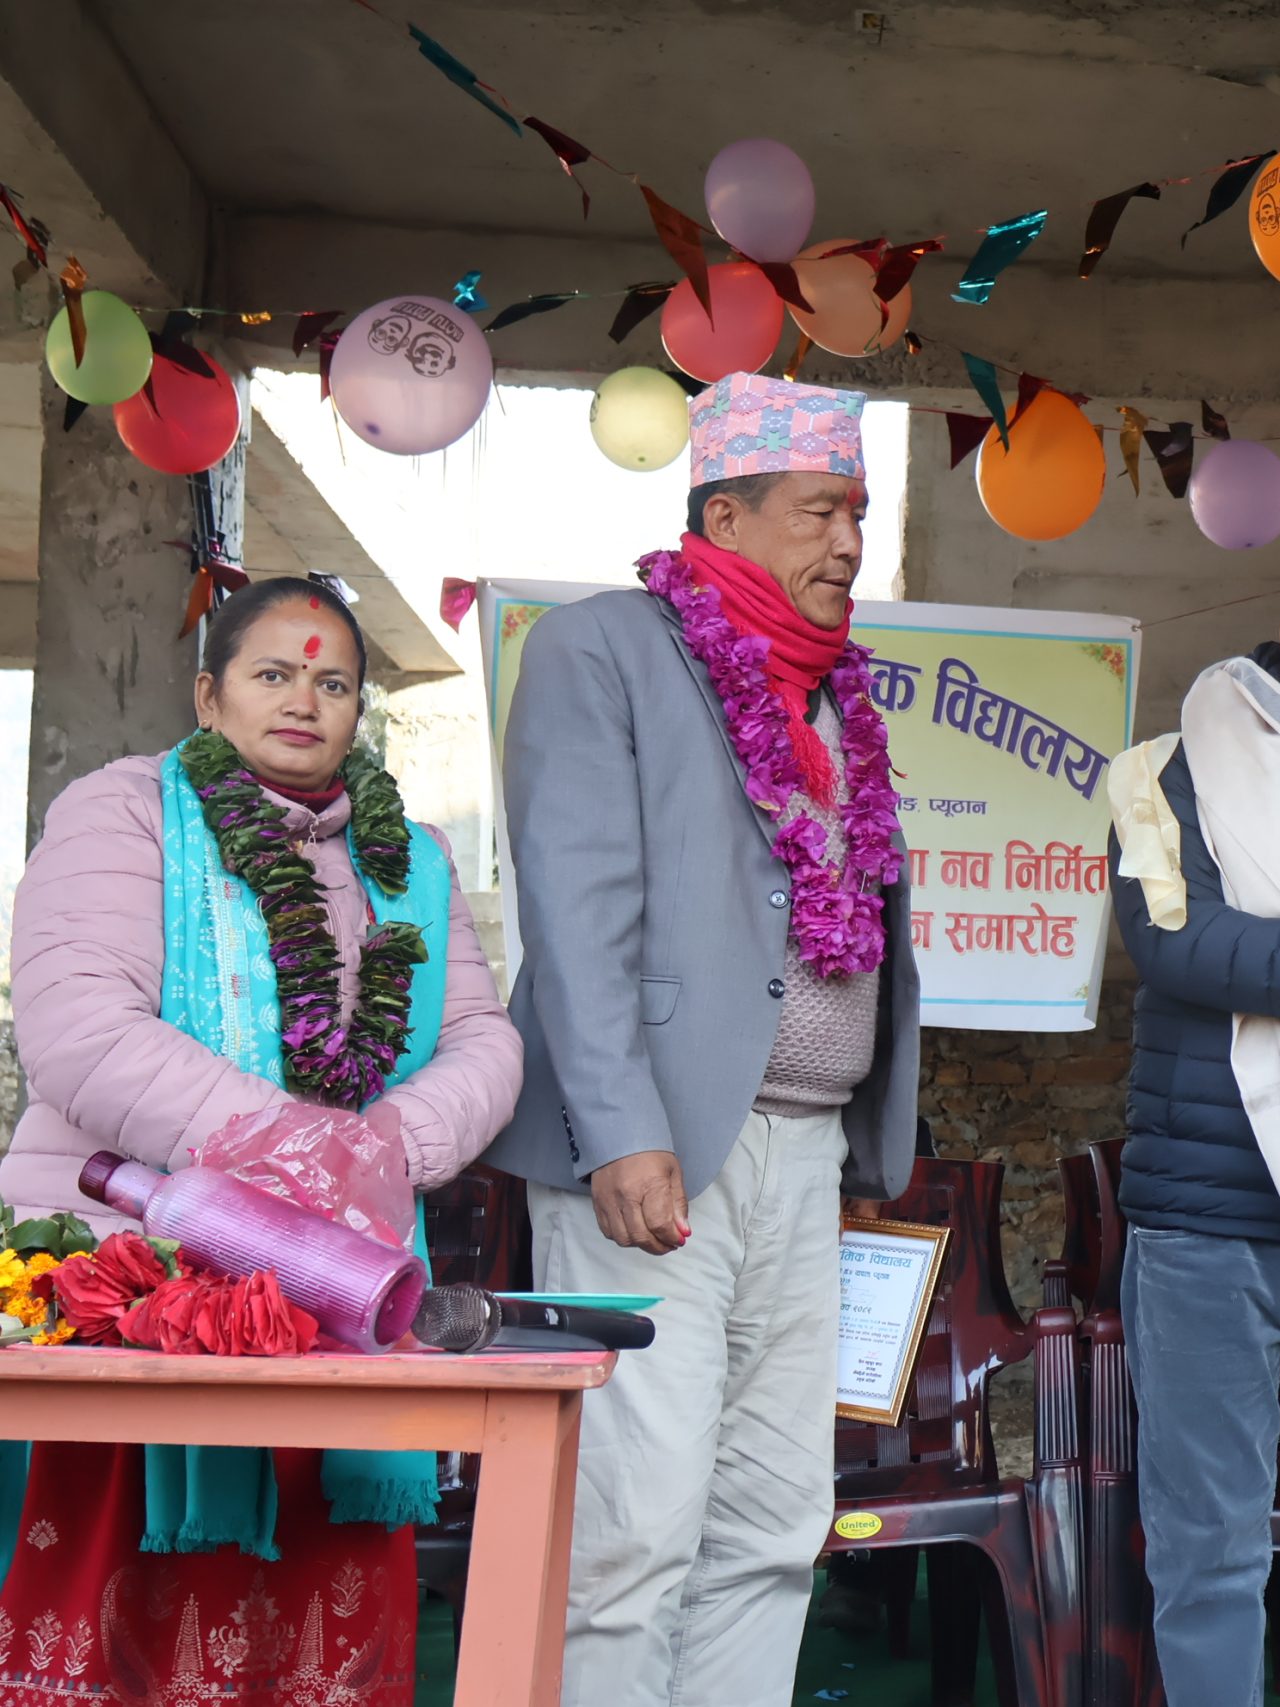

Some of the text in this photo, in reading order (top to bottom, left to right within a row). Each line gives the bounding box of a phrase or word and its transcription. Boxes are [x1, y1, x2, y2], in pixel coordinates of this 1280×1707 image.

[868, 657, 1110, 801] क विद्यालय
[928, 798, 987, 818] प्यूठान
[940, 850, 994, 890] नव
[1004, 839, 1108, 894] निर्मित
[944, 902, 1078, 958] समारोह
[841, 1519, 876, 1530] United
